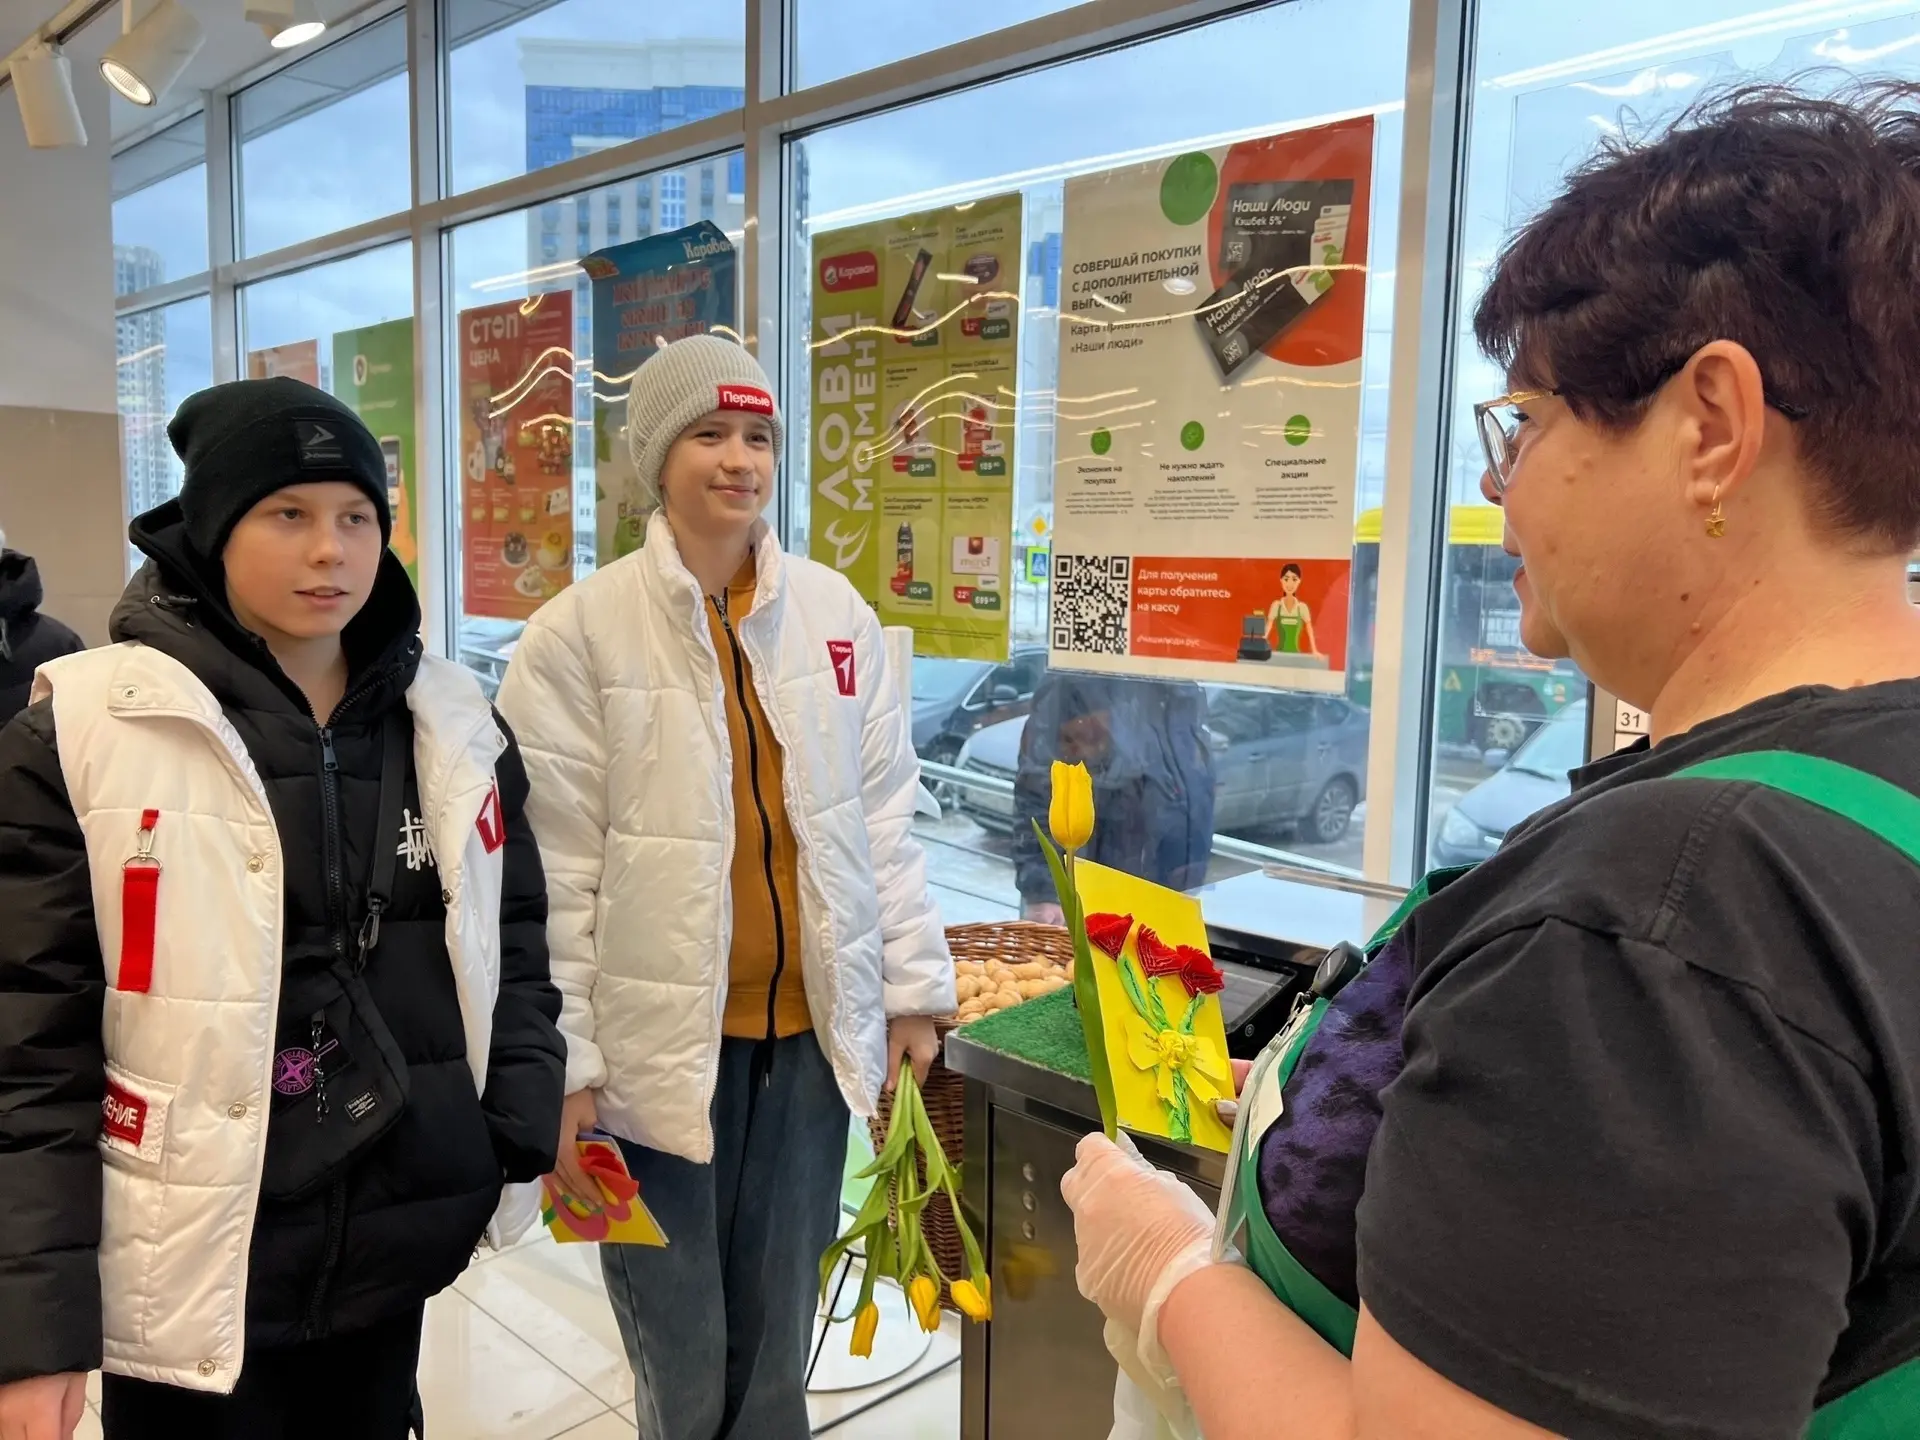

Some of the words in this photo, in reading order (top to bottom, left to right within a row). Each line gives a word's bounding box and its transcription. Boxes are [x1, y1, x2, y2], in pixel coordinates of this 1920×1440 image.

[1232, 199, 1268, 213] Наши
[1271, 198, 1312, 214] Люди
[1072, 252, 1139, 275] СОВЕРШАЙ
[1141, 244, 1202, 264] ПОКУПКИ
[1072, 282, 1080, 293] С
[1081, 261, 1200, 293] ДОПОЛНИТЕЛЬНОЙ
[469, 312, 518, 345] СТОП
[1070, 324, 1101, 337] Карта
[1107, 338, 1144, 351] люди»
[469, 347, 500, 368] ЦЕНА
[723, 390, 771, 407] Первые
[817, 314, 852, 512] ЛОВИ
[852, 310, 877, 511] МОМЕНТ
[1137, 568, 1159, 581] Для
[1160, 571, 1219, 583] получения
[1137, 586, 1168, 597] карты
[1169, 586, 1232, 599] обратитесь
[1136, 602, 1149, 612] на
[1151, 604, 1180, 615] кассу
[1620, 712, 1640, 728] 31
